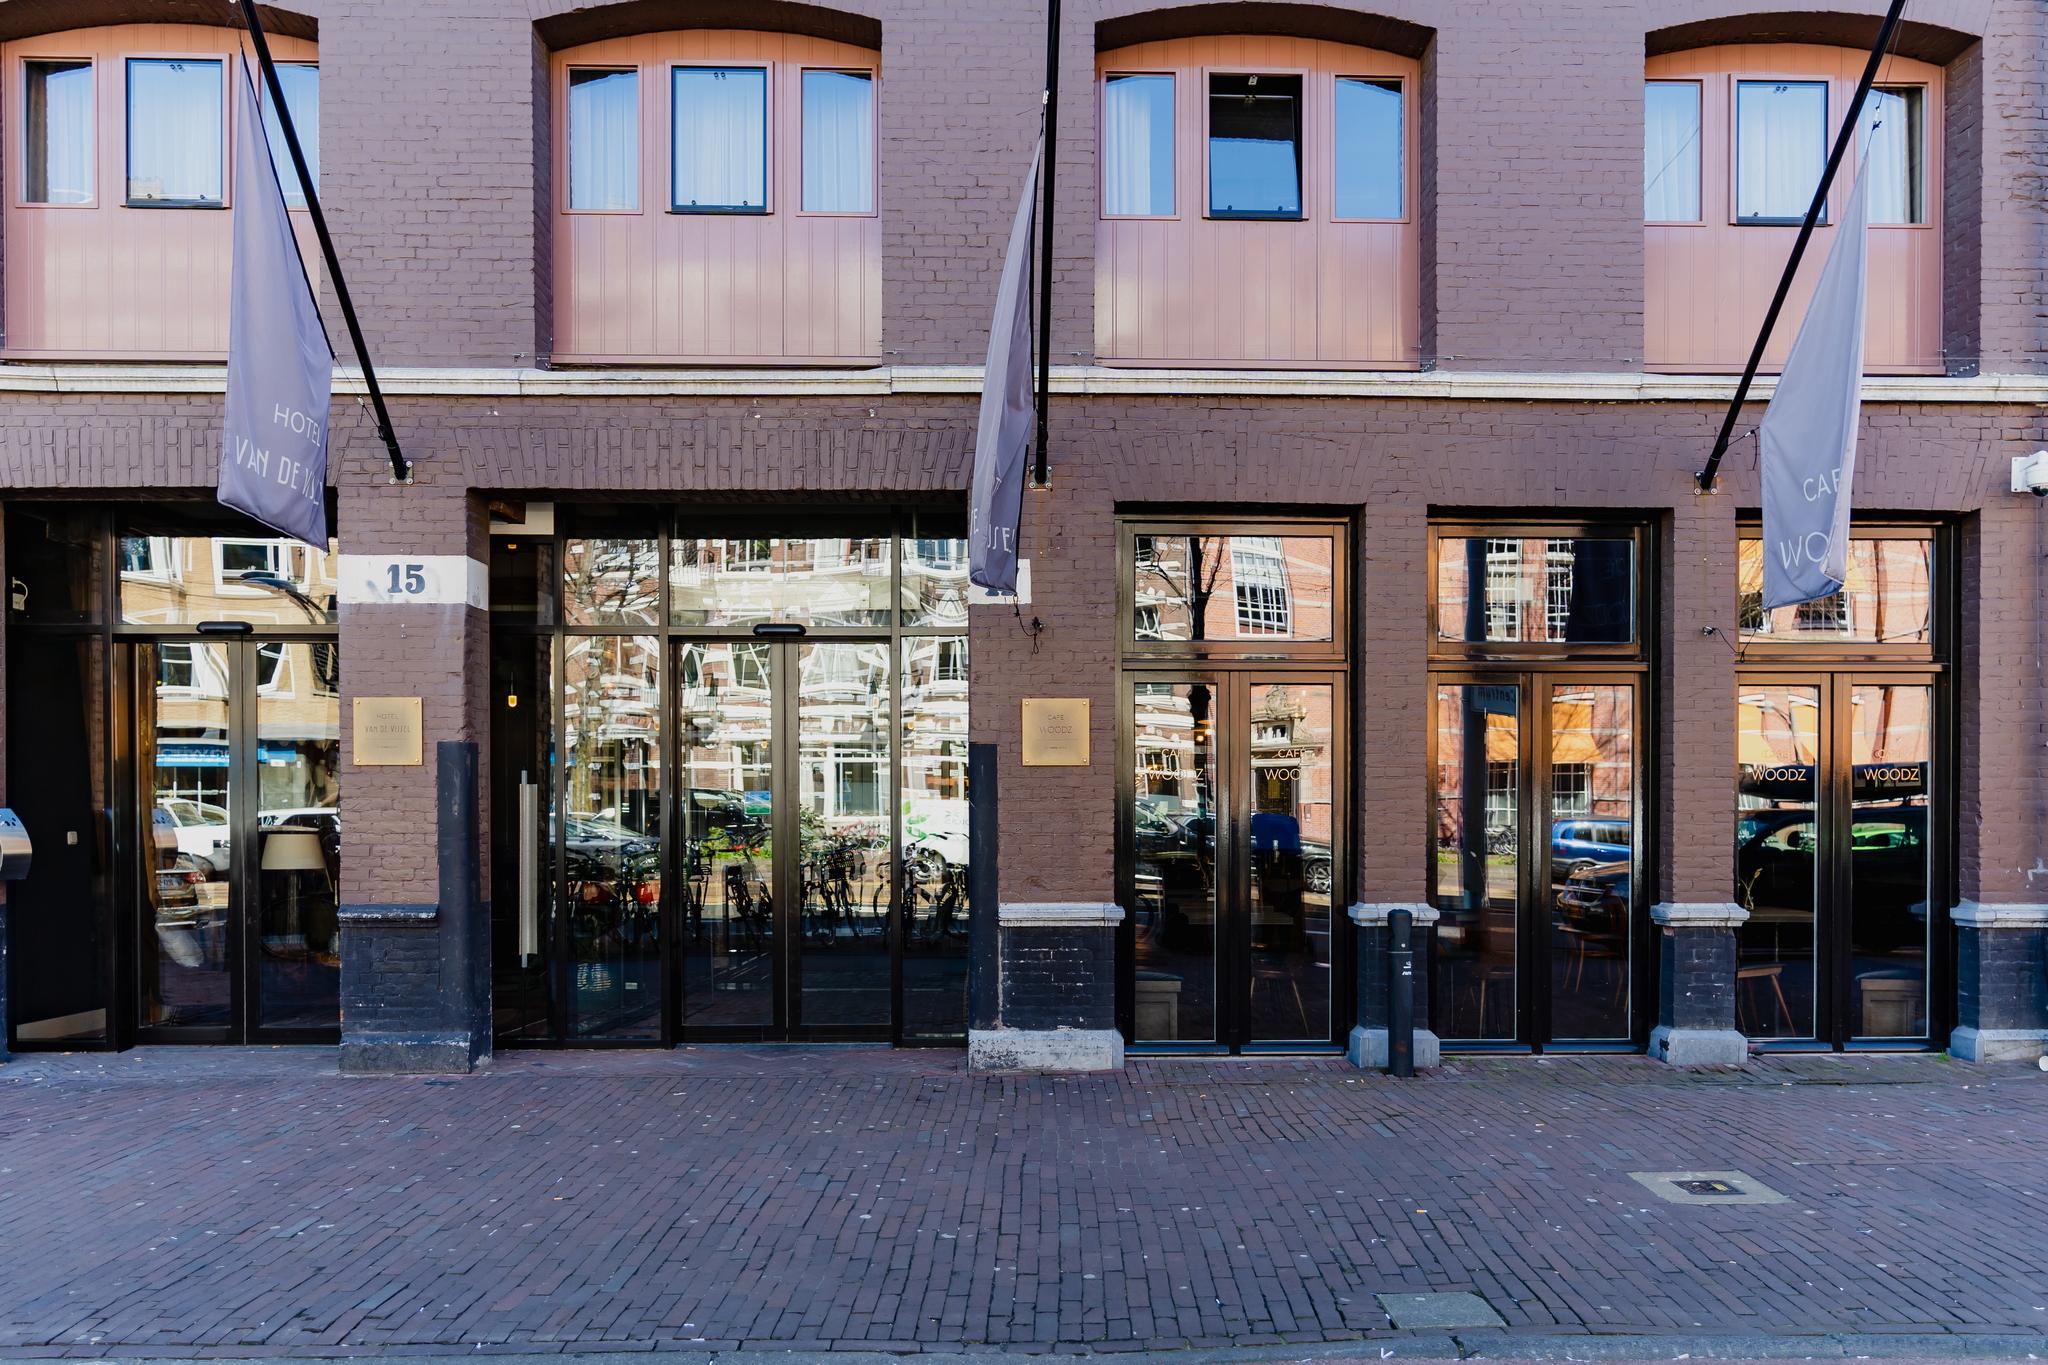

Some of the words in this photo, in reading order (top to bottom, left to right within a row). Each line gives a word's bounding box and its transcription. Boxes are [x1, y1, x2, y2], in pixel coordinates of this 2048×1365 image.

[274, 403, 321, 448] HOTEL
[236, 436, 270, 478] VAN
[278, 456, 301, 490] DE
[1803, 468, 1841, 501] CAF
[1780, 531, 1830, 570] WO
[387, 564, 426, 595] 15
[1040, 725, 1073, 735] WOODZ
[1148, 768, 1204, 781] WOOZ
[1752, 768, 1807, 781] WOODZ
[1864, 768, 1920, 781] WOODZ
